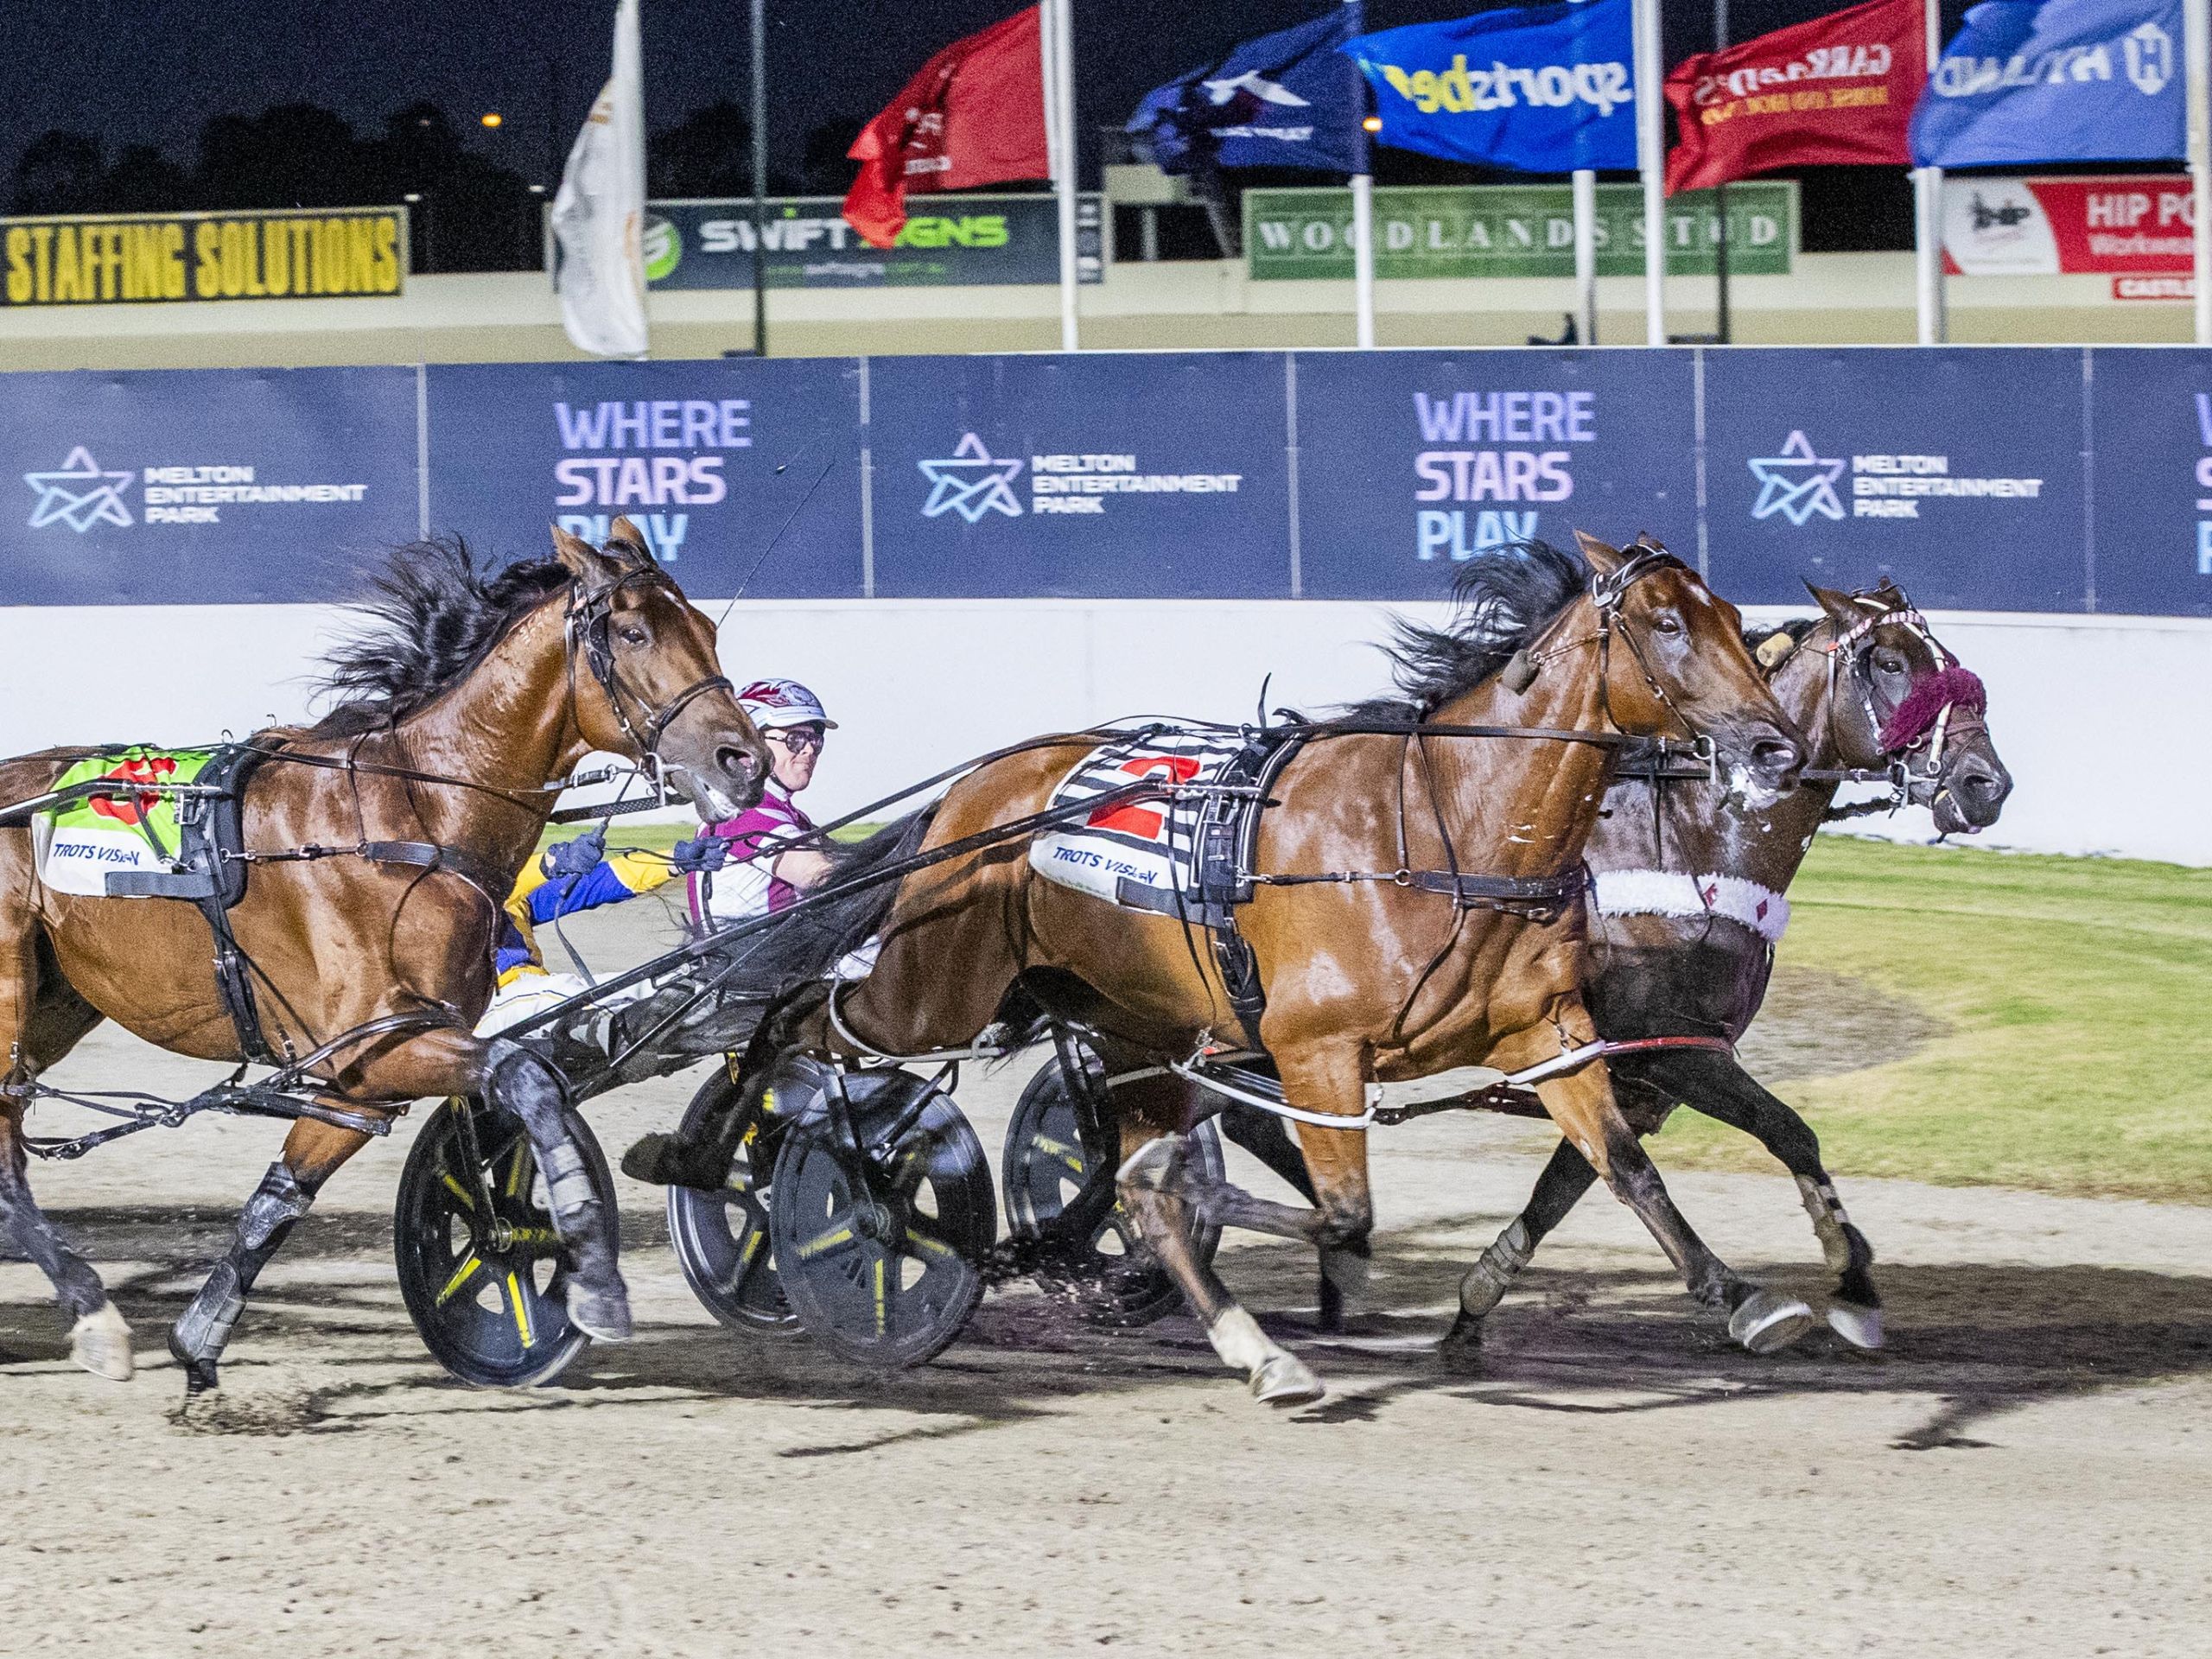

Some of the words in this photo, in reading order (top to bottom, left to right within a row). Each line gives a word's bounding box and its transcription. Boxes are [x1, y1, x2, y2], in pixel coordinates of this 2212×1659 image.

[2087, 192, 2150, 227] HIP
[699, 208, 851, 252] SWIFT
[857, 215, 1009, 249] GNS
[1632, 216, 1778, 247] STUD
[6, 223, 185, 302] STAFFING
[195, 217, 397, 297] SOLUTIONS
[554, 399, 752, 449] WHERE
[1414, 391, 1596, 442] WHERE
[1032, 454, 1136, 472] MELTON
[1853, 454, 1948, 474] MELTON
[144, 466, 254, 485] MELTON
[555, 456, 728, 506] STARS
[1032, 474, 1243, 493] ENTERTAINMENT
[1414, 450, 1574, 501] STARS
[144, 485, 368, 505] ENTERTAINMENT
[1853, 476, 2044, 498] ENTERTAINMENT
[145, 506, 219, 524] PARK
[1033, 496, 1106, 514] PARK
[1853, 499, 1919, 518] PARK
[53, 842, 97, 859] TROTS
[1052, 846, 1103, 868] TROTS
